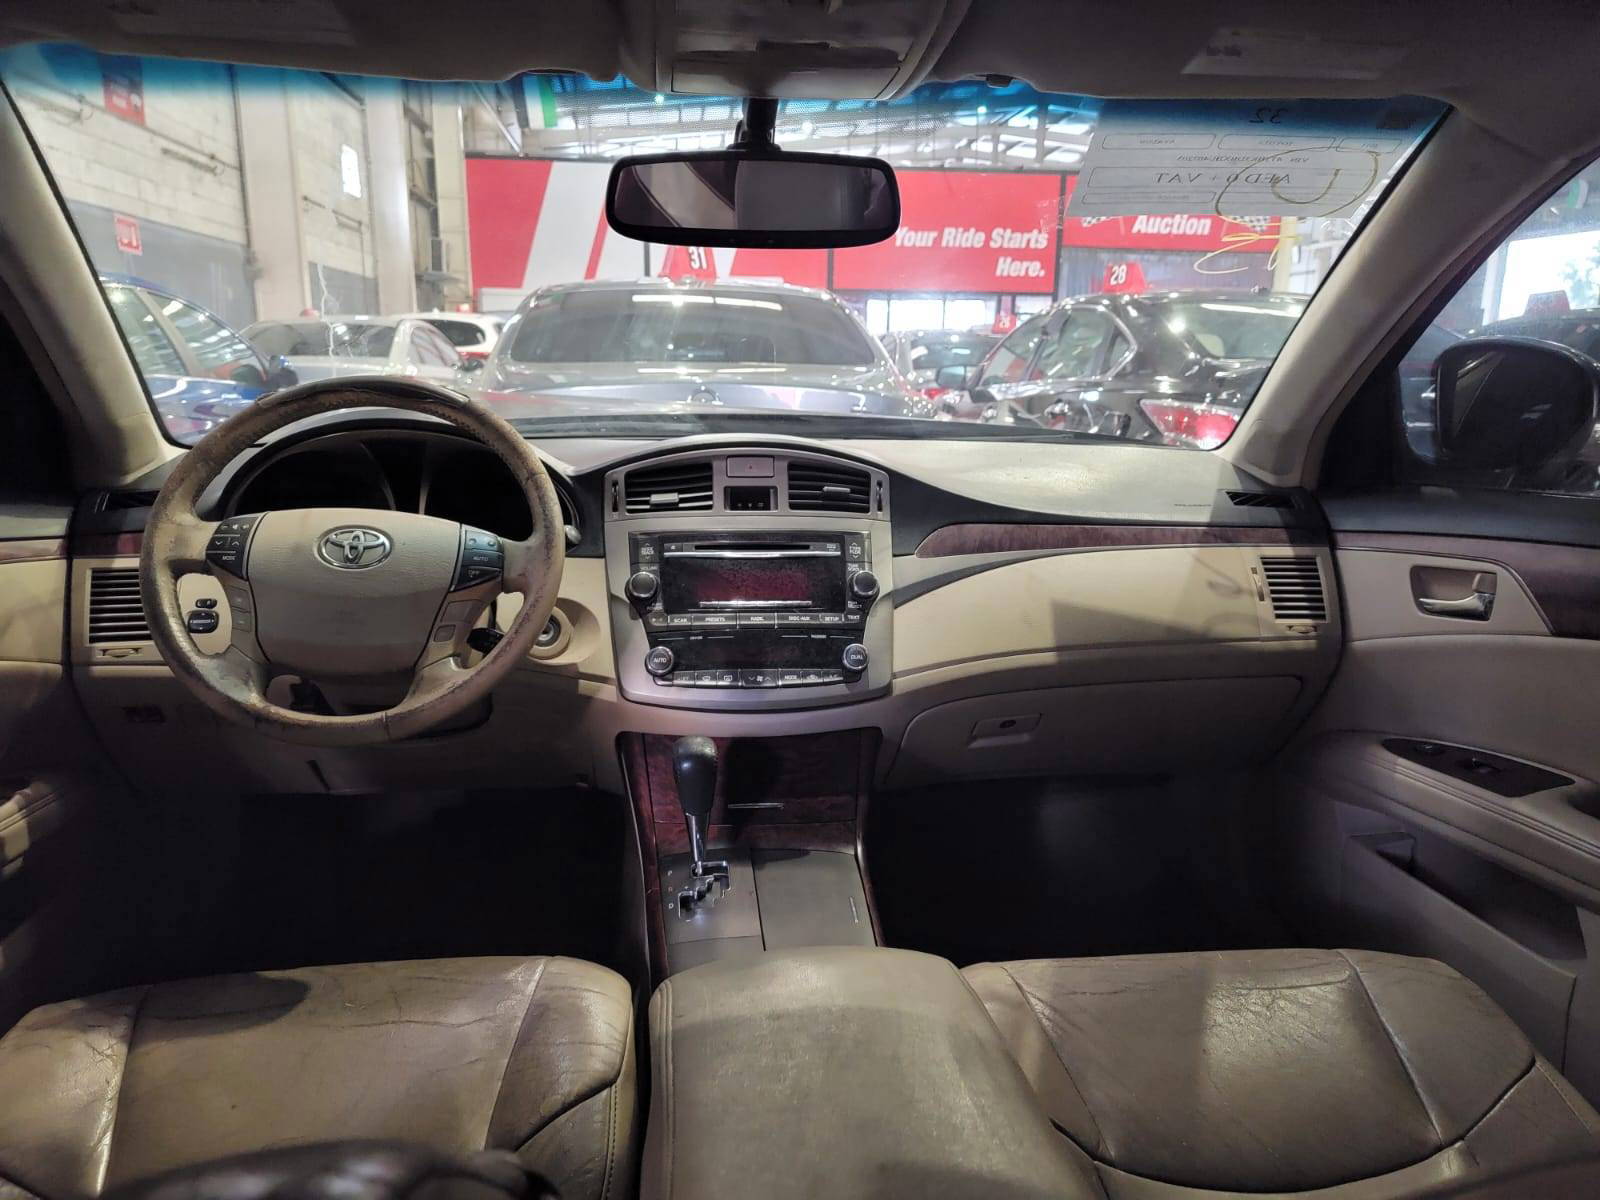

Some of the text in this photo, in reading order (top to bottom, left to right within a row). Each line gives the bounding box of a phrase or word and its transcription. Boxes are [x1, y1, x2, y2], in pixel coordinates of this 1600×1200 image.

[1131, 214, 1212, 235] Auction
[895, 226, 1049, 249] Your Ride Starts
[688, 246, 708, 270] 31
[995, 256, 1046, 277] Here.
[1110, 264, 1128, 285] 28
